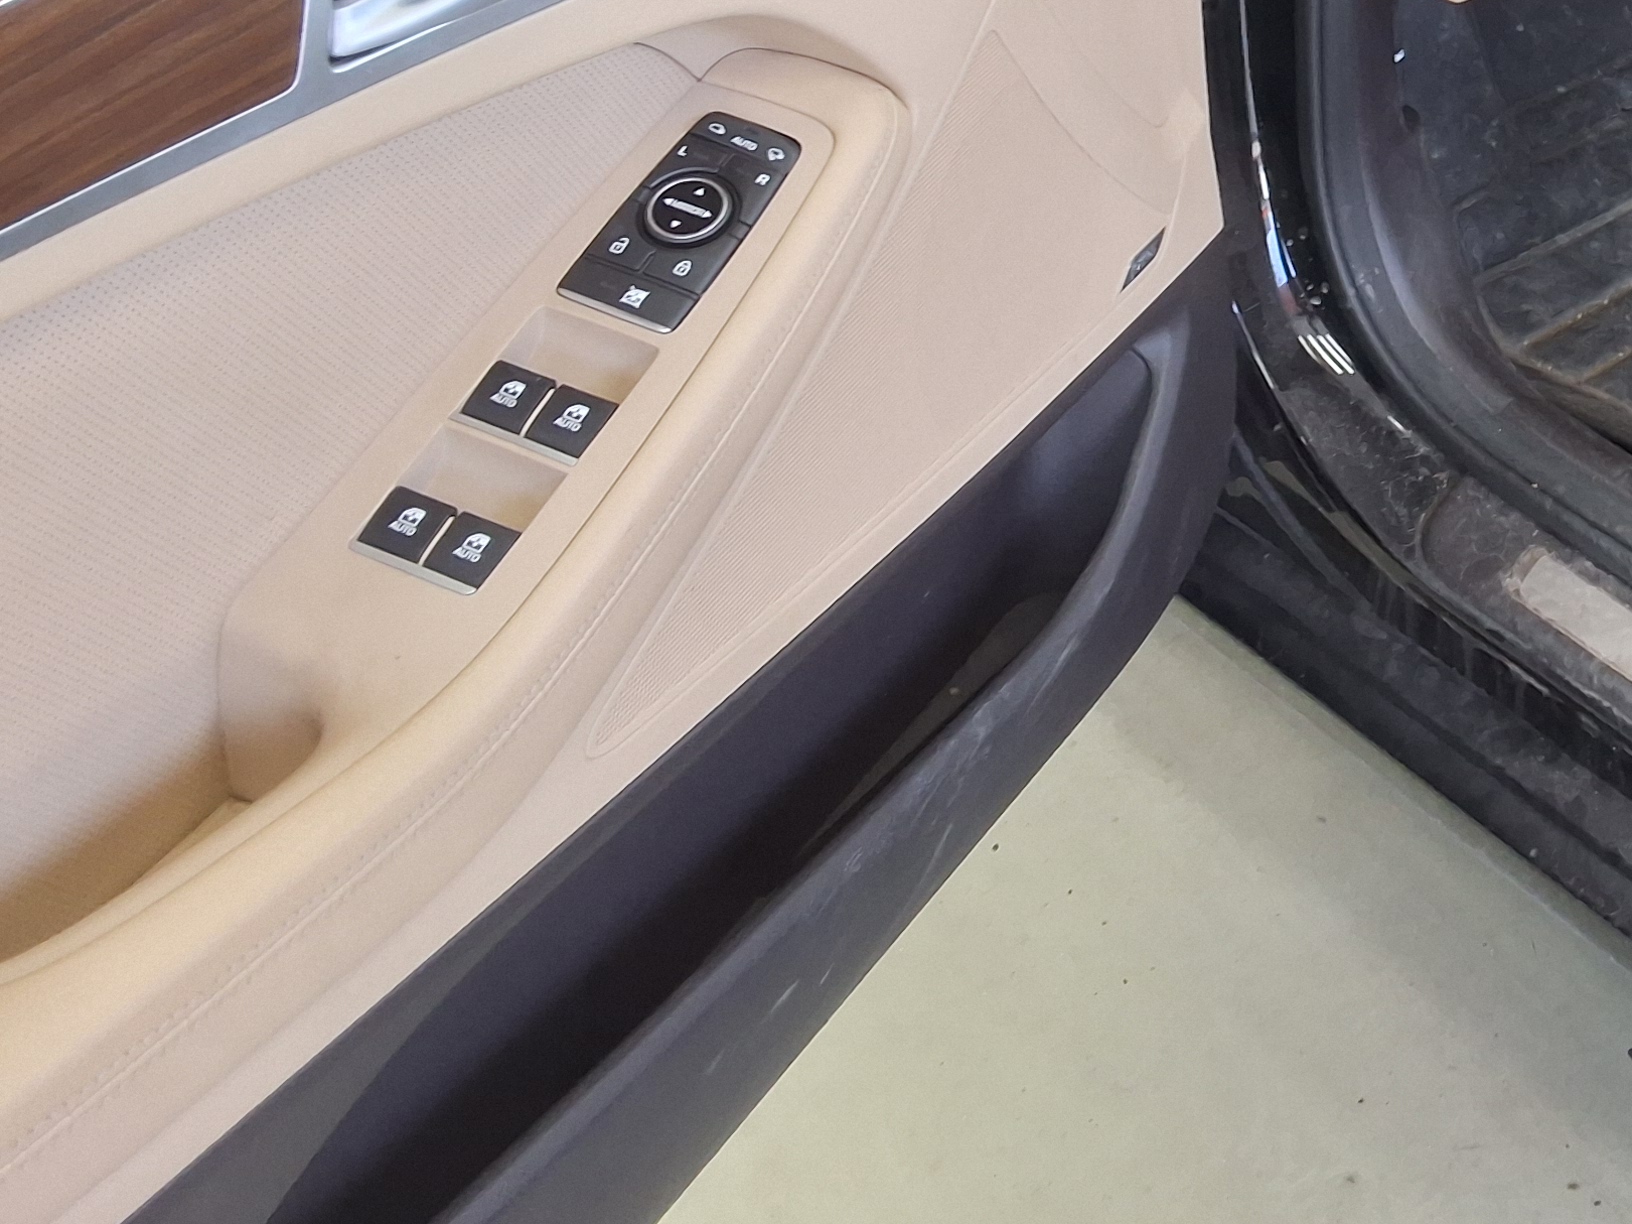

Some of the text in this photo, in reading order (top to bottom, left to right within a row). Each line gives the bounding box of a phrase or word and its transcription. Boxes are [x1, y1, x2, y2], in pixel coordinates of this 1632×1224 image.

[677, 145, 690, 157] L
[730, 136, 759, 151] AUTO
[754, 173, 771, 186] R
[490, 393, 518, 408] AUTO
[553, 416, 582, 432] AUTO
[388, 520, 417, 537] AUTO
[452, 546, 482, 563] AUTO
